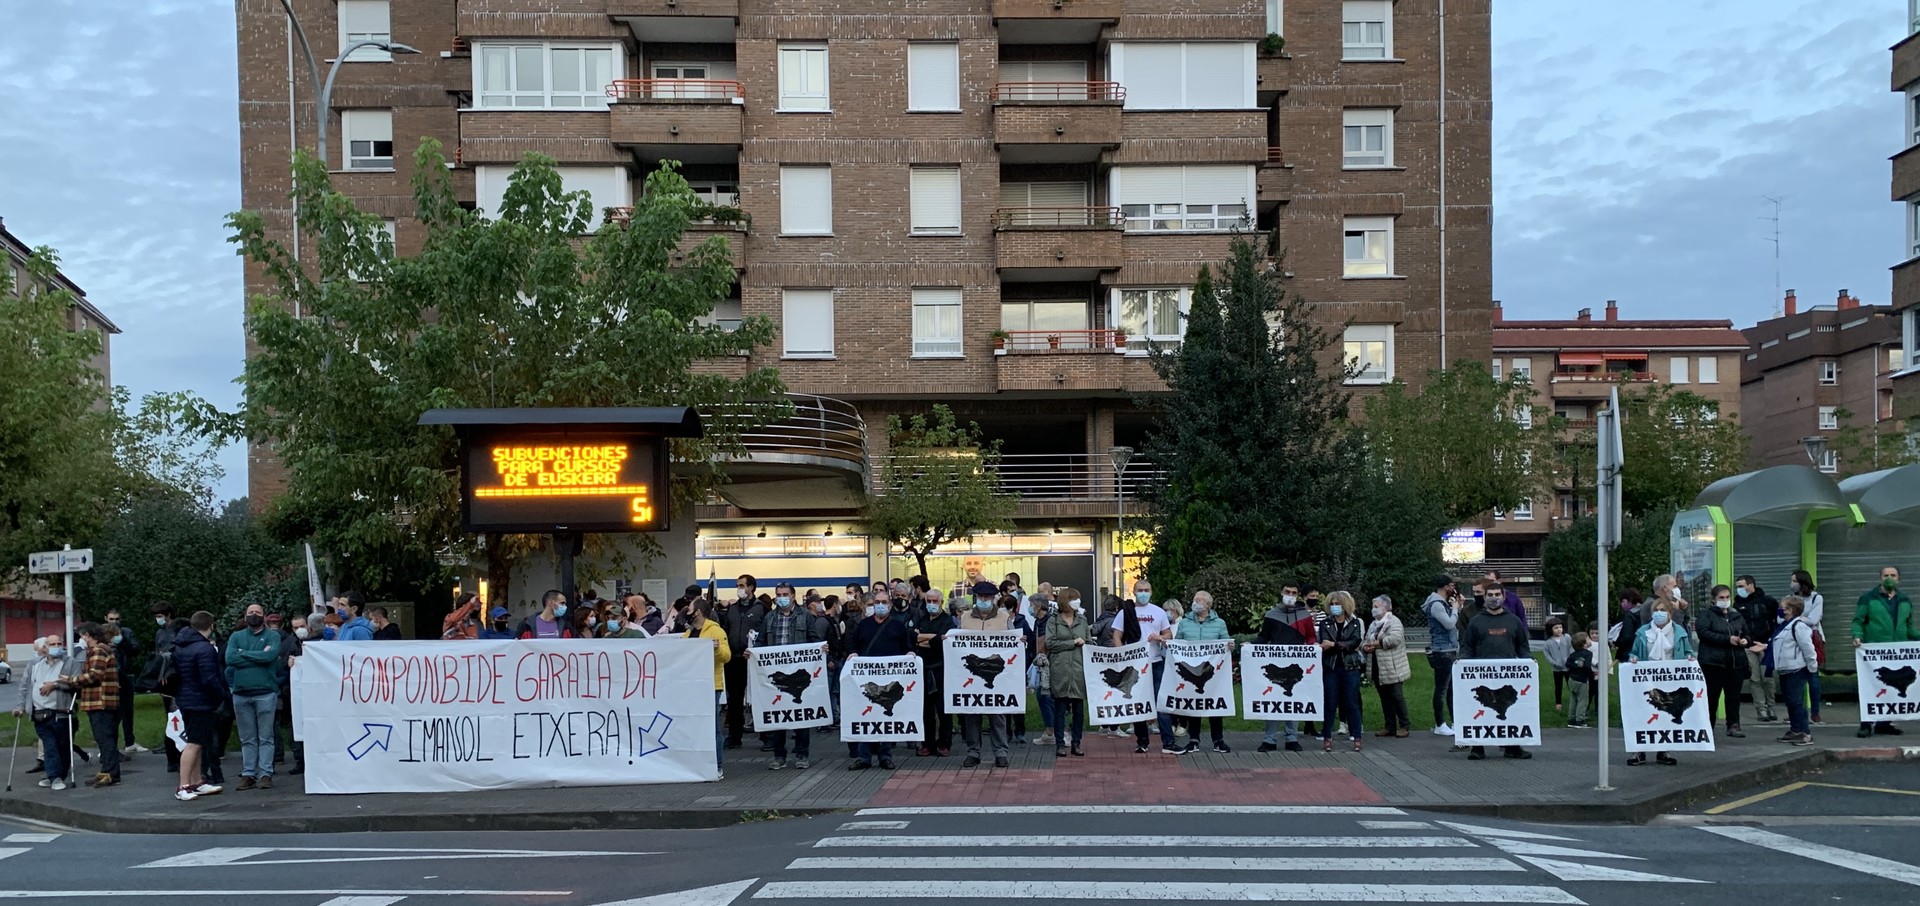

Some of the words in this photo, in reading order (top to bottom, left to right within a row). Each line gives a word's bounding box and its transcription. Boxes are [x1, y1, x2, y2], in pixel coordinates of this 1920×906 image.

[492, 446, 628, 462] SUBVENCIONES
[497, 461, 544, 474] PARA
[553, 459, 622, 473] CURSOS
[504, 473, 528, 487] DE
[537, 472, 617, 486] EUSKERA
[759, 652, 791, 660] EUSKAL
[794, 648, 821, 657] PRESO
[1107, 652, 1149, 663] IHESLARIAK
[1124, 646, 1146, 656] PRESO
[1181, 648, 1226, 657] IHESLARIAK
[775, 655, 823, 665] IHESLARIAK
[339, 653, 506, 705] KONPONBIDE
[515, 651, 611, 702] GARAIA
[623, 650, 657, 700] DA
[868, 668, 918, 676] IHESLARIAK
[952, 694, 1019, 707] ETXERA
[1166, 695, 1228, 710] ETXERA
[1252, 701, 1317, 714] ETXERA
[762, 706, 829, 724] ETXERA
[1096, 701, 1152, 718] ETXERA
[851, 721, 918, 734] ETXERA
[1463, 725, 1534, 739] ETXERA
[398, 716, 494, 762] IMANOL
[513, 706, 634, 765] ETXERA!
[1636, 728, 1710, 744] ETXERA
